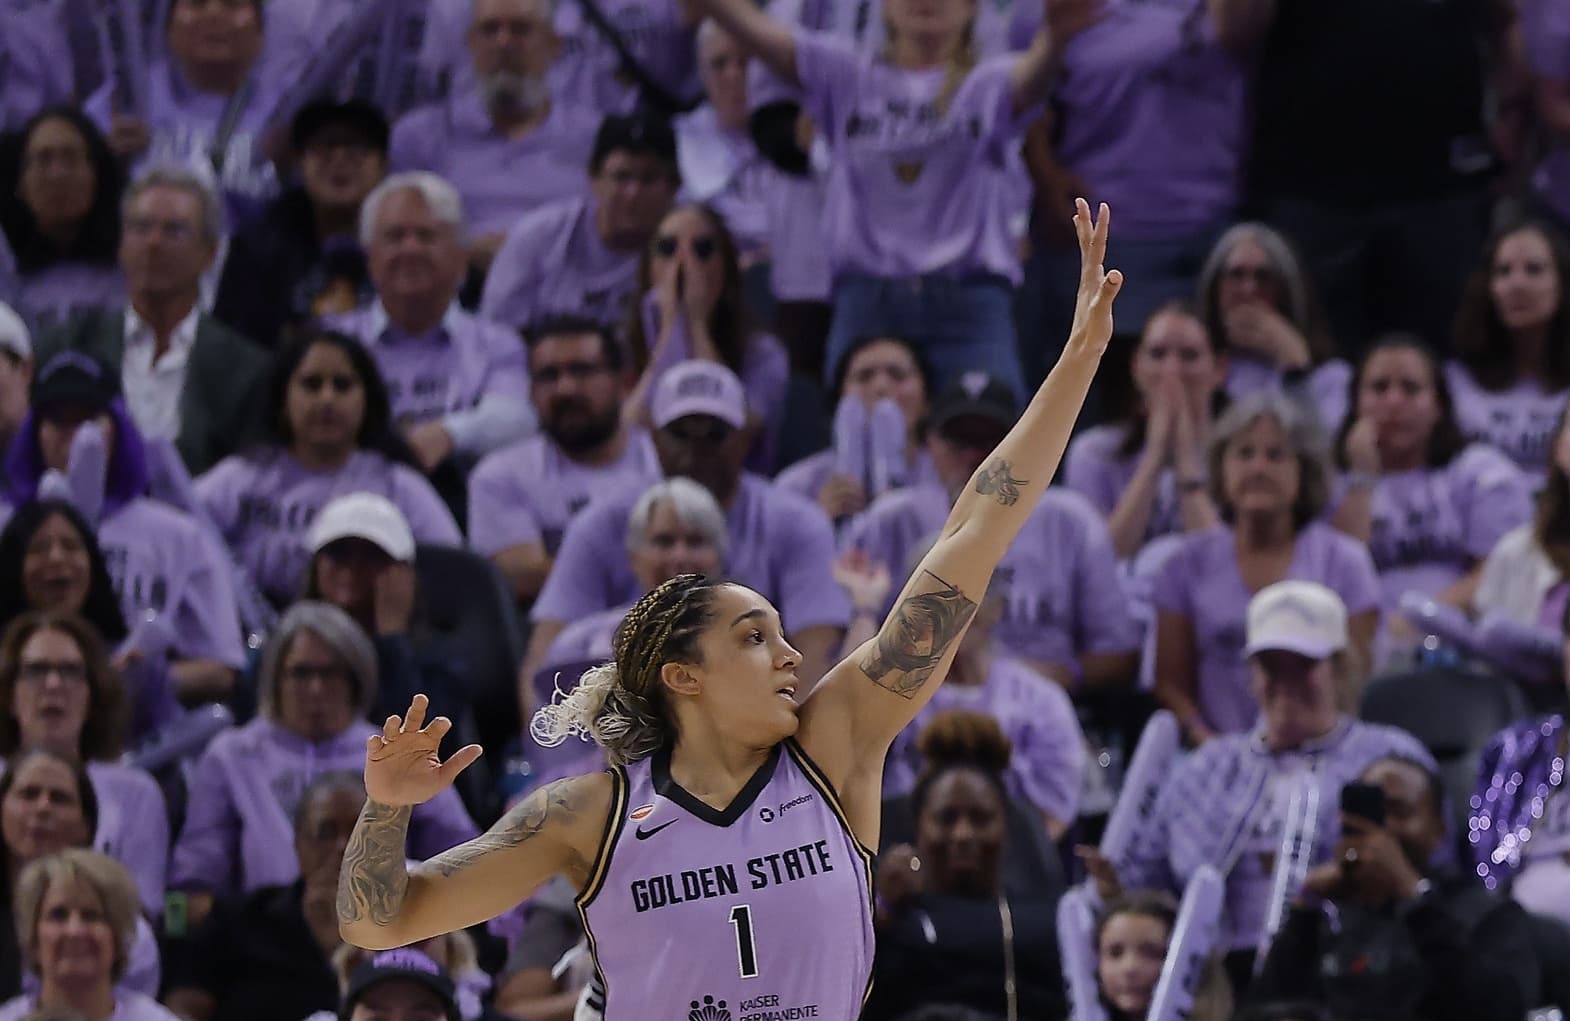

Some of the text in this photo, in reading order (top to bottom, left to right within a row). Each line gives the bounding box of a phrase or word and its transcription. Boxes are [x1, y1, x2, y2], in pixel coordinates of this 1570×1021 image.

[779, 794, 813, 817] freedom
[631, 839, 834, 913] GOLDEN STATE
[728, 903, 759, 979] 1
[739, 994, 780, 1013] KAISER
